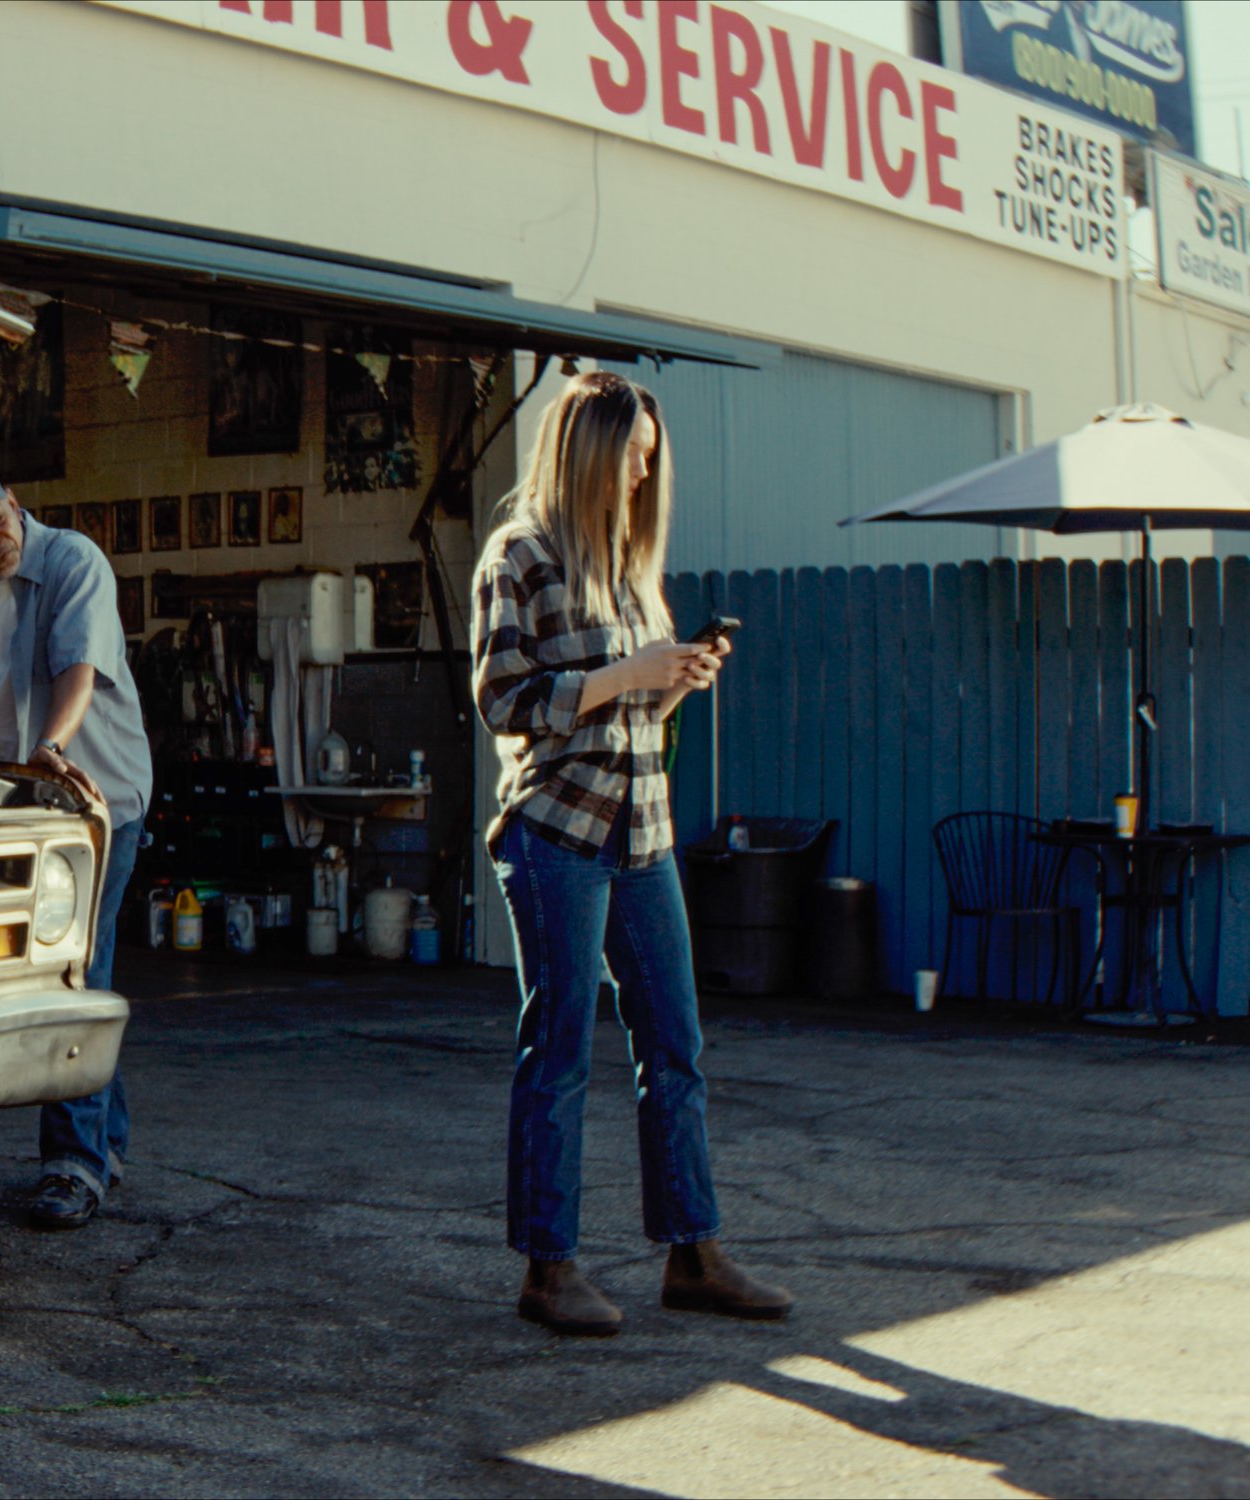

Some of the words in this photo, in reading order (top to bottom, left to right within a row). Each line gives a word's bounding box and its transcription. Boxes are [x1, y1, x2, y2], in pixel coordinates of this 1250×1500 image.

[447, 1, 533, 86] &
[588, 1, 963, 213] SERVICE
[1018, 114, 1115, 180] BRAKES
[1014, 155, 1118, 219] SHOCKS
[1196, 185, 1250, 254] Sal
[994, 190, 1119, 261] TUNE-UPS
[1177, 240, 1244, 294] Garden
